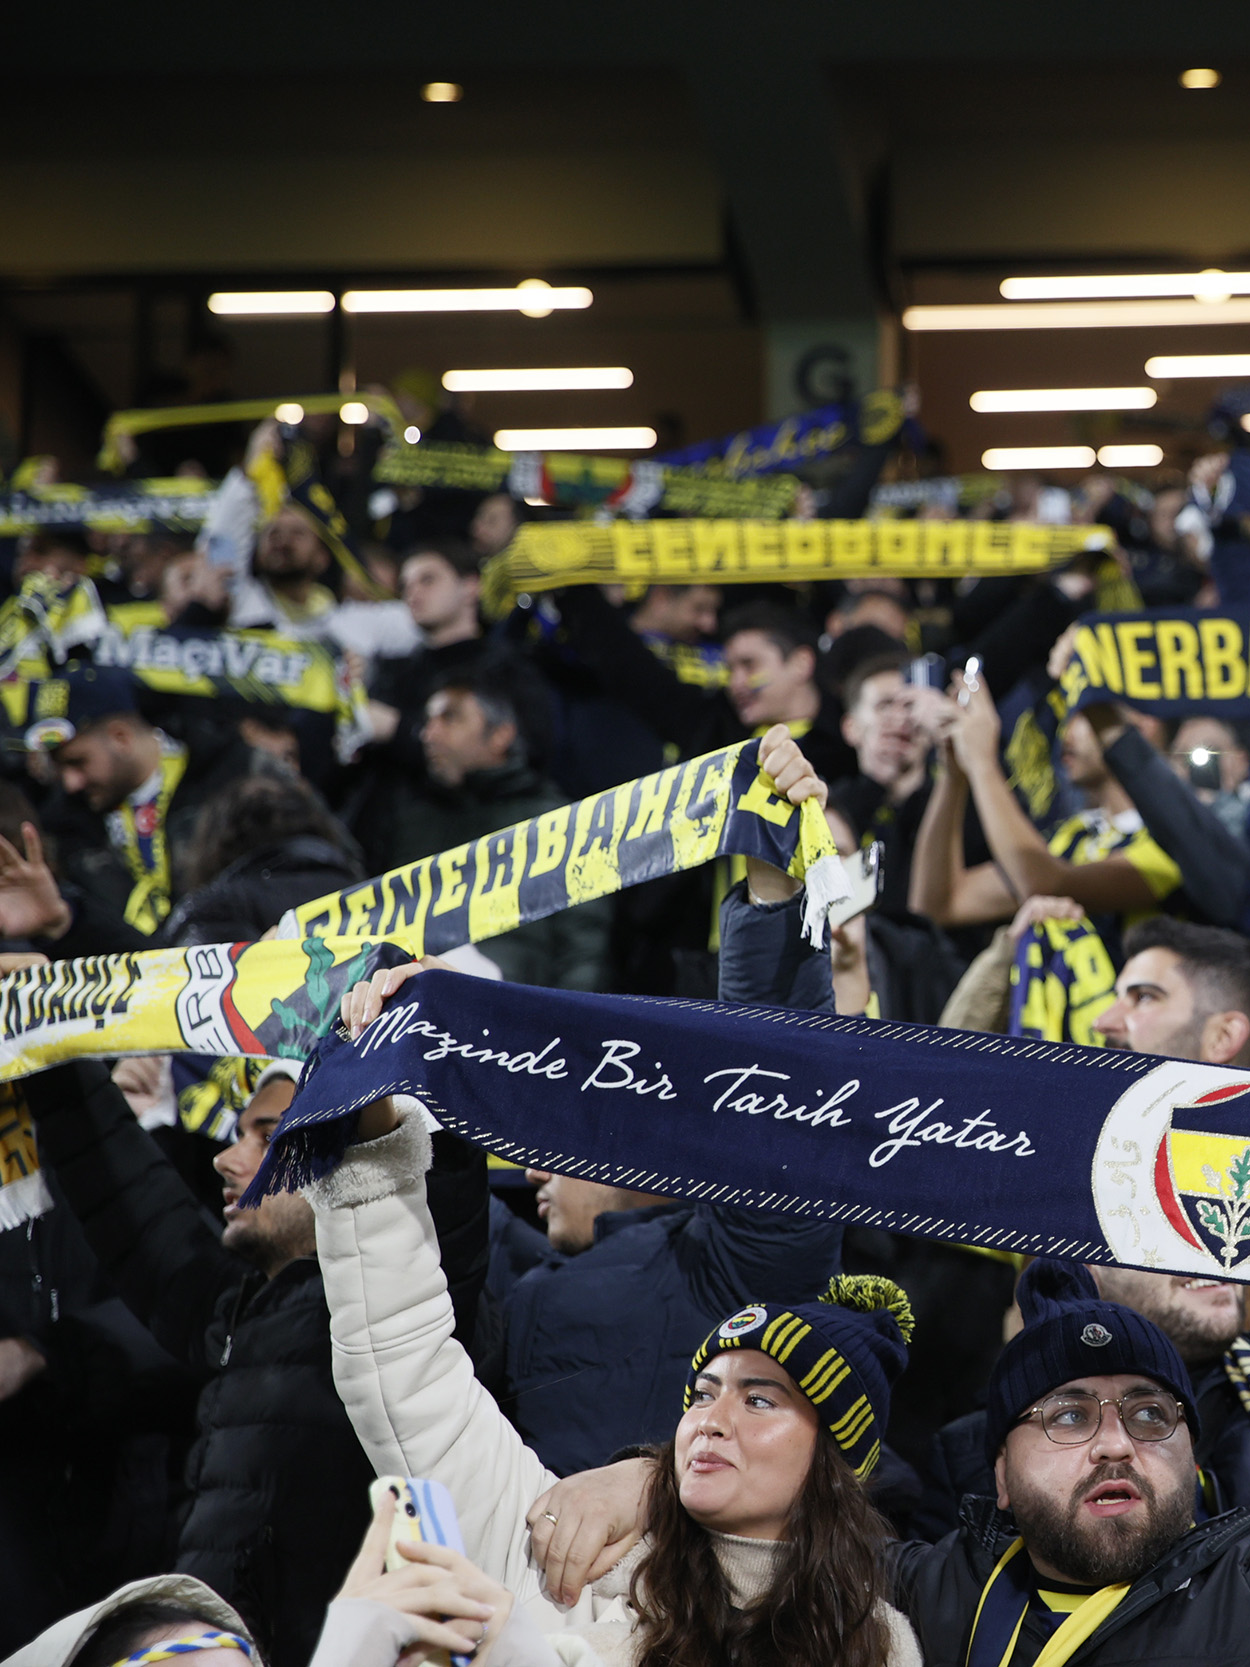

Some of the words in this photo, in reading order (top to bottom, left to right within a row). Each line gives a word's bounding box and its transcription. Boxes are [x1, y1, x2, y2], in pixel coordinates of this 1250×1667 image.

[354, 1002, 568, 1079] Mazinde
[581, 1039, 677, 1100] Bir
[704, 1064, 860, 1127] Tarih
[869, 1097, 1036, 1168] Yatar
